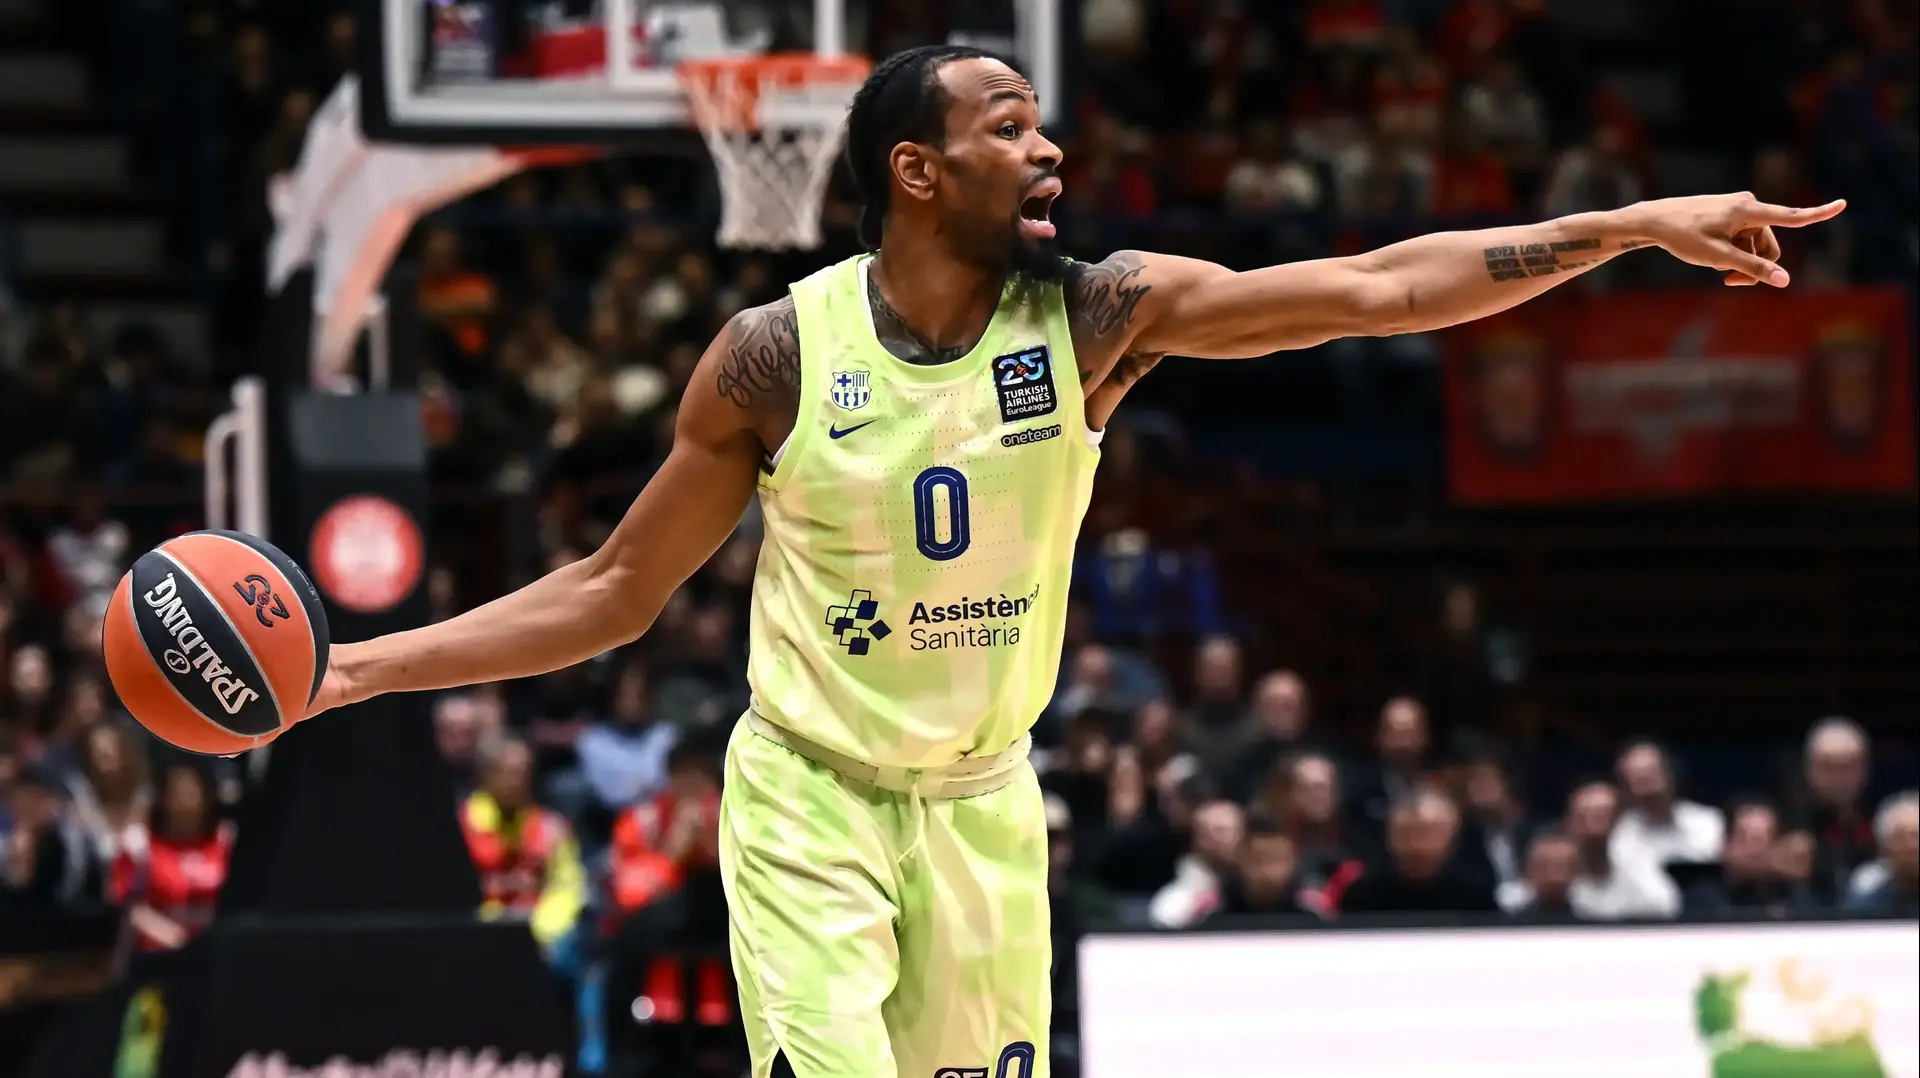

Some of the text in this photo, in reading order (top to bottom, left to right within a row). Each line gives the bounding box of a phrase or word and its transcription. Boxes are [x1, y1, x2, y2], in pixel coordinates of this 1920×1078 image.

[998, 351, 1045, 386] 25
[1004, 384, 1049, 400] TURKISH
[1006, 392, 1051, 408] AIRLINES
[1006, 401, 1052, 416] EuroLeague
[1001, 424, 1061, 447] oneteam
[913, 466, 970, 561] 0
[143, 573, 260, 715] SPALDING
[910, 621, 1020, 651] Sanitària
